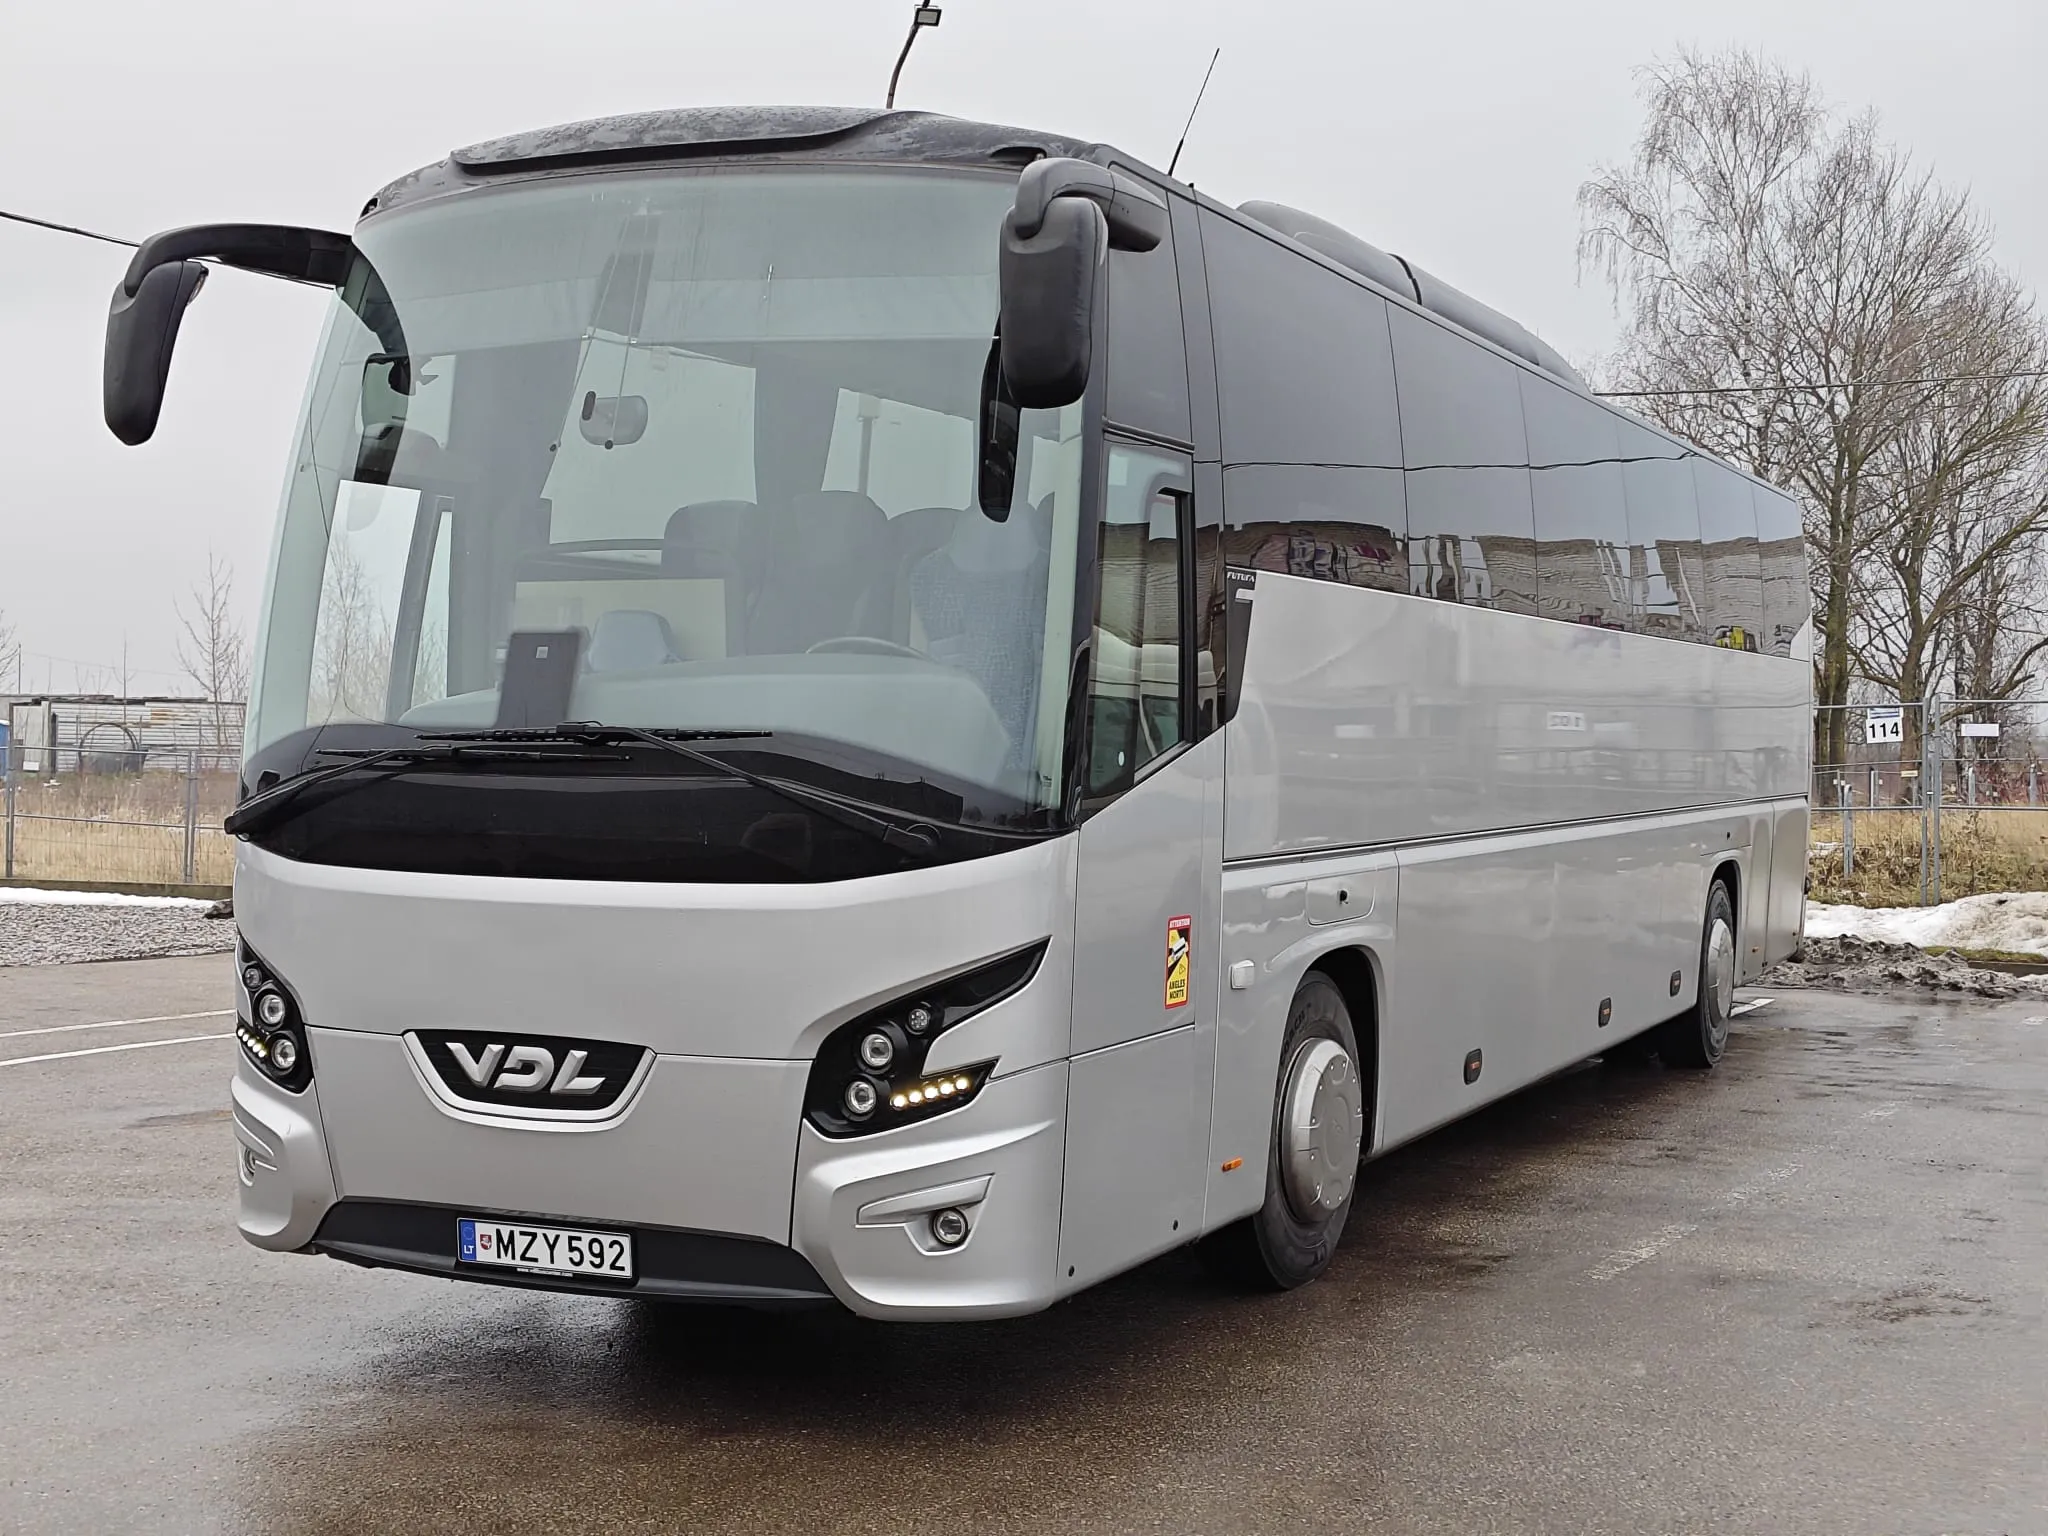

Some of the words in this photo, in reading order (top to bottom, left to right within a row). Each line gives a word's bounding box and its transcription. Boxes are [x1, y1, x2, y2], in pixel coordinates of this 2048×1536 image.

[1227, 571, 1255, 582] FUTURA
[1869, 722, 1900, 738] 114
[1169, 978, 1185, 990] ANGLES
[445, 1042, 606, 1095] VDL
[463, 1244, 475, 1255] LT
